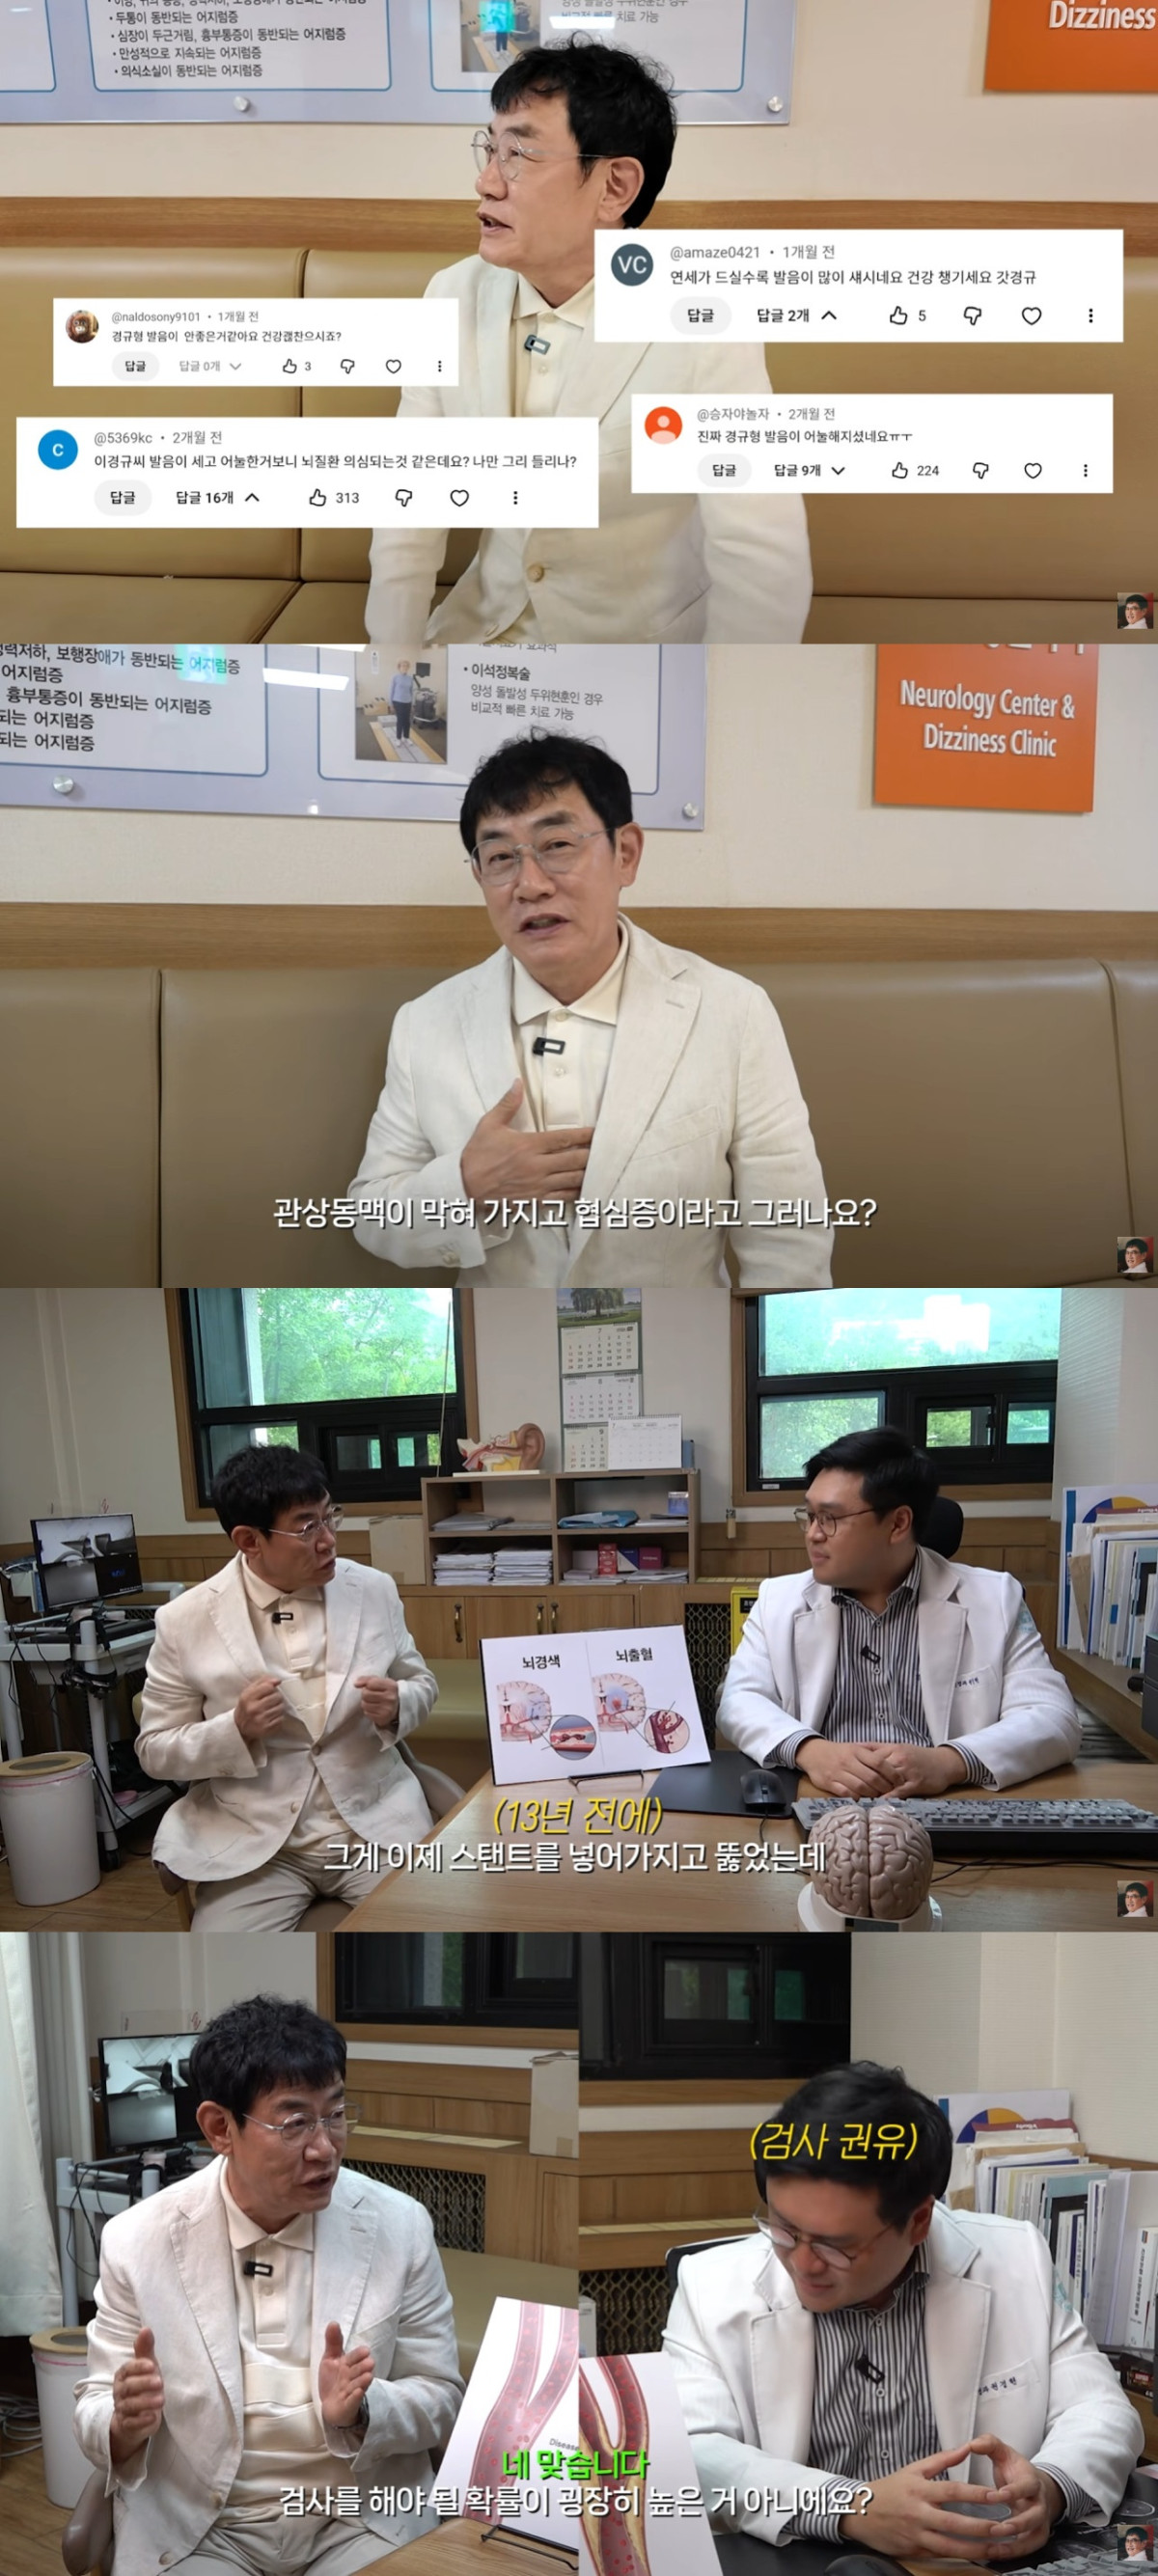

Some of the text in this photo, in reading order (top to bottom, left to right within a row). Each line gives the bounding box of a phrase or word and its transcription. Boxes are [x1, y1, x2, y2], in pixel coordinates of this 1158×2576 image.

[116, 11, 238, 24] 두통이 동반되는 어지럼증
[617, 11, 636, 22] 치료
[640, 11, 659, 23] 가능
[1049, 0, 1156, 29] Dizziness
[118, 27, 346, 42] 심장이 두근거림, 흉부통증이 동반되는 어지럼증
[119, 46, 262, 60] 만성적으로 지속되는 어지럼증
[121, 64, 262, 77] 의식소실이 동반되는 어지럼증
[0, 644, 240, 675] 력저하, 보행장애가 동반되는 어지럼증
[2, 664, 63, 684] 어지럼증
[472, 663, 531, 681] 이석정복술
[6, 686, 212, 716] 흉부통증이 동반되는 어지럼증
[471, 684, 492, 699] 양성
[496, 686, 527, 700] 돌발성
[584, 693, 603, 706] 경우
[900, 679, 1075, 720] Neurology Center &
[34, 711, 95, 730] 어지럼증
[471, 701, 574, 721] 비교적 빠른 치료 가능
[35, 733, 95, 752] 어지럼증
[924, 723, 1058, 757] Dizziness Clinic
[522, 1654, 561, 1671] 뇌경색
[616, 1647, 653, 1663] 뇌출혈
